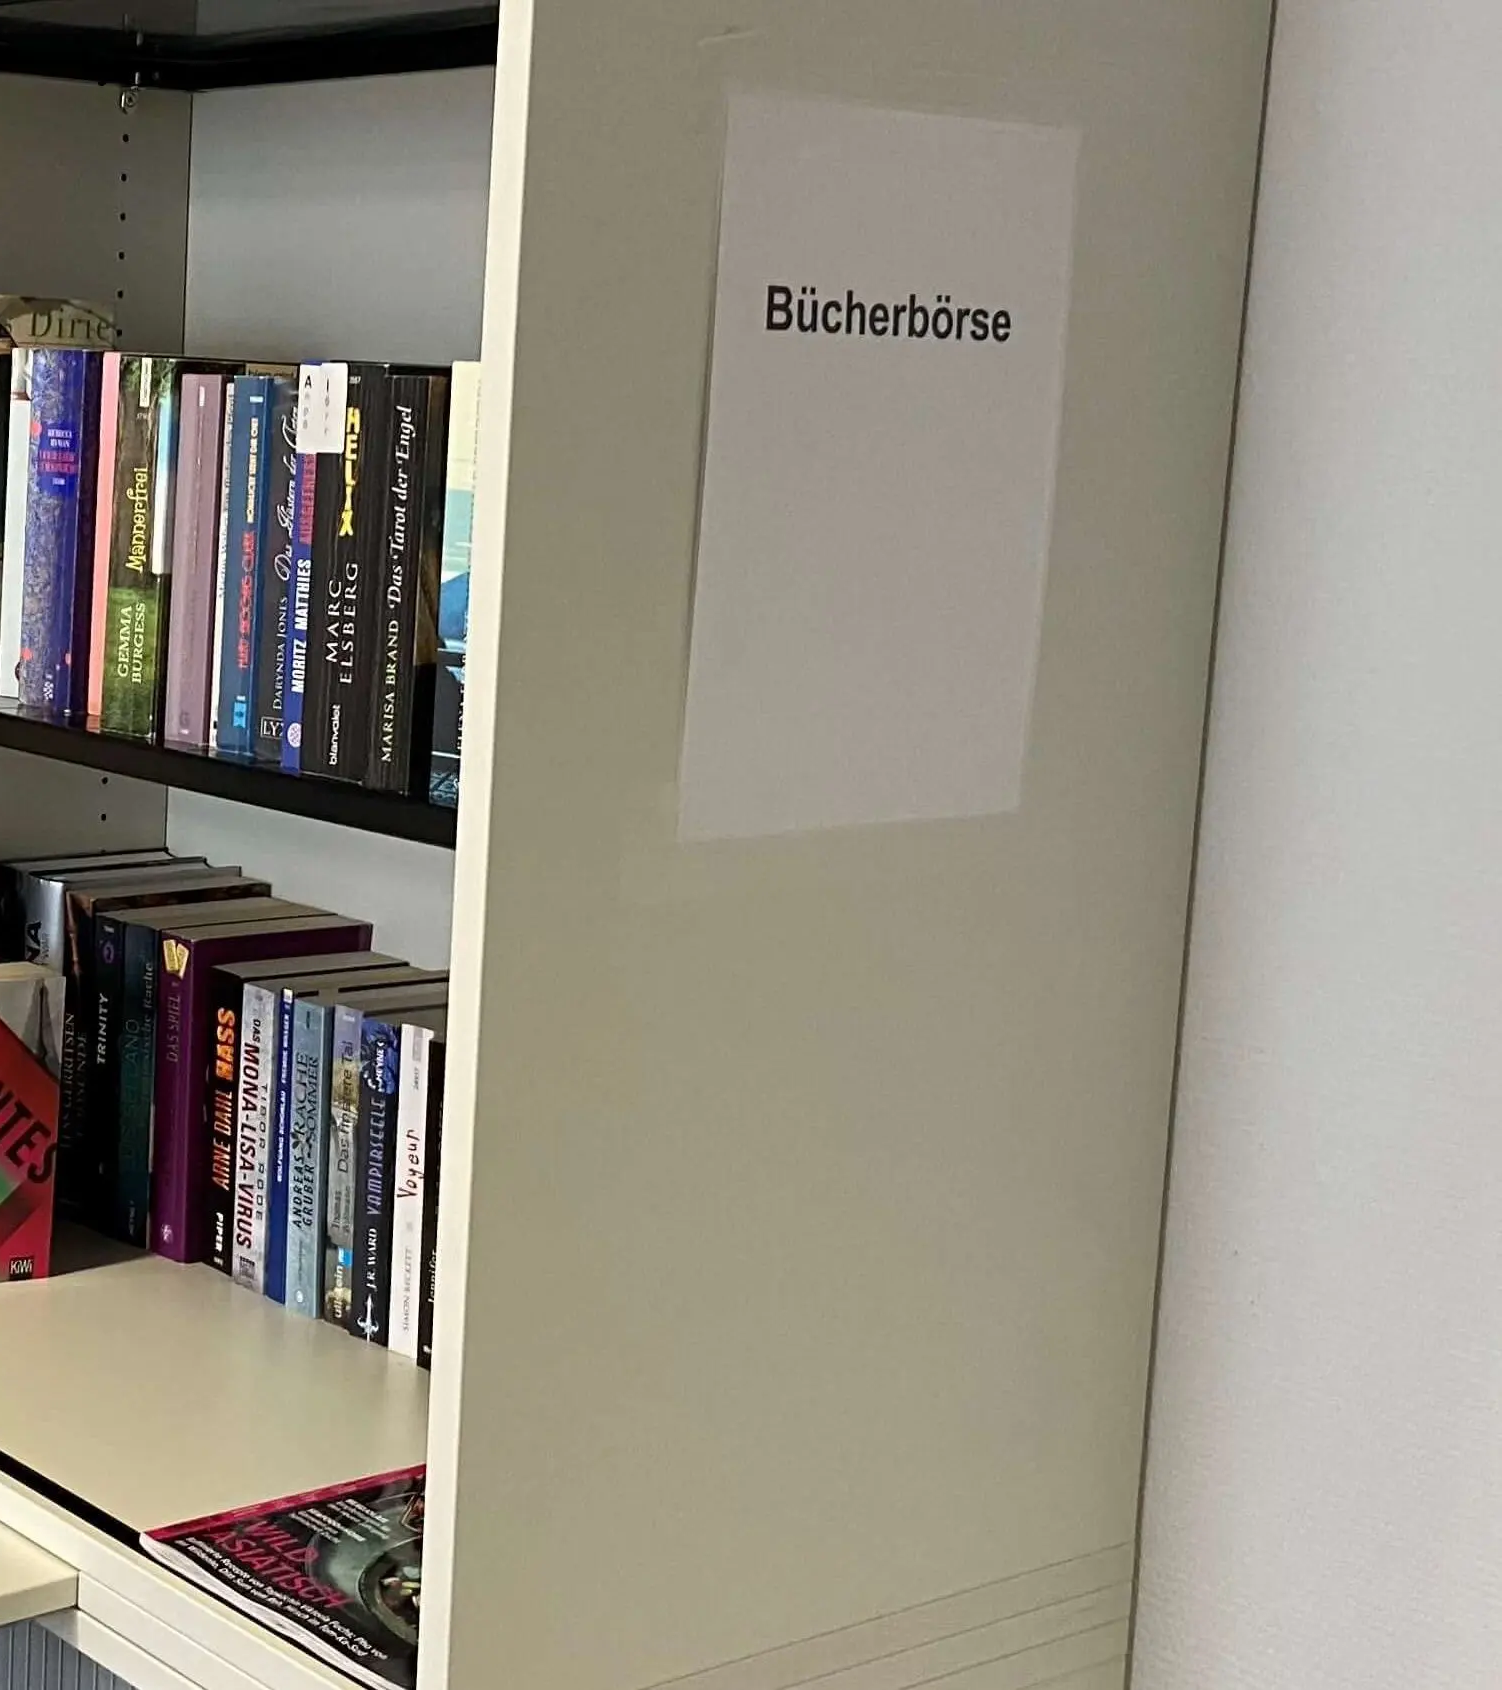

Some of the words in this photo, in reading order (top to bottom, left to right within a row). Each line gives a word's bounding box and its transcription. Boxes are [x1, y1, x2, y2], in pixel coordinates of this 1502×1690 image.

[766, 285, 1011, 342] Bücherbörse
[393, 405, 416, 465] Engel
[338, 407, 361, 537] HELIX
[392, 467, 409, 501] der
[273, 544, 294, 582] Das
[389, 505, 407, 560] Tarot
[274, 596, 288, 638] JONES
[294, 559, 312, 630] MATTHIES
[386, 565, 404, 609] Das
[116, 604, 132, 677] GEMMA
[131, 602, 146, 685] BURGESS
[325, 579, 343, 663] MARC
[339, 562, 359, 685] ELSBERG
[383, 618, 400, 686] BRAND
[272, 643, 287, 710] DARYNDA
[291, 640, 306, 694] MORITZ
[328, 703, 341, 766] blanvalet
[380, 690, 396, 763] MARISA
[96, 992, 109, 1066] TRINITY
[167, 993, 181, 1032] SPIEL
[251, 1018, 262, 1043] DAS
[166, 1035, 180, 1063] DAS
[215, 1008, 236, 1082] HASS
[213, 1089, 233, 1137] DAHL
[258, 1082, 268, 1150] TIBOR
[292, 1051, 309, 1136] RACHE
[306, 1054, 319, 1143] SOMMER
[337, 1067, 353, 1135] finstere
[212, 1137, 232, 1191] ARNE
[236, 1042, 260, 1250] MONA-LISA-VIRUS
[336, 1139, 350, 1174] Das
[368, 1098, 386, 1216] VAMPIRSEELE
[396, 1128, 424, 1199] Voyeur
[255, 1162, 265, 1223] RODE
[291, 1156, 305, 1230] ANDREAS
[302, 1163, 314, 1228] GRUBER
[330, 1189, 342, 1232] Thomas
[215, 1211, 225, 1252] PIPER
[365, 1227, 379, 1266] WARD
[332, 1264, 345, 1319] ullstein
[402, 1247, 413, 1291] BECKETT
[401, 1295, 411, 1332] SIMON
[204, 1531, 355, 1608] ASIATISCH
[245, 1519, 319, 1563] WILD
